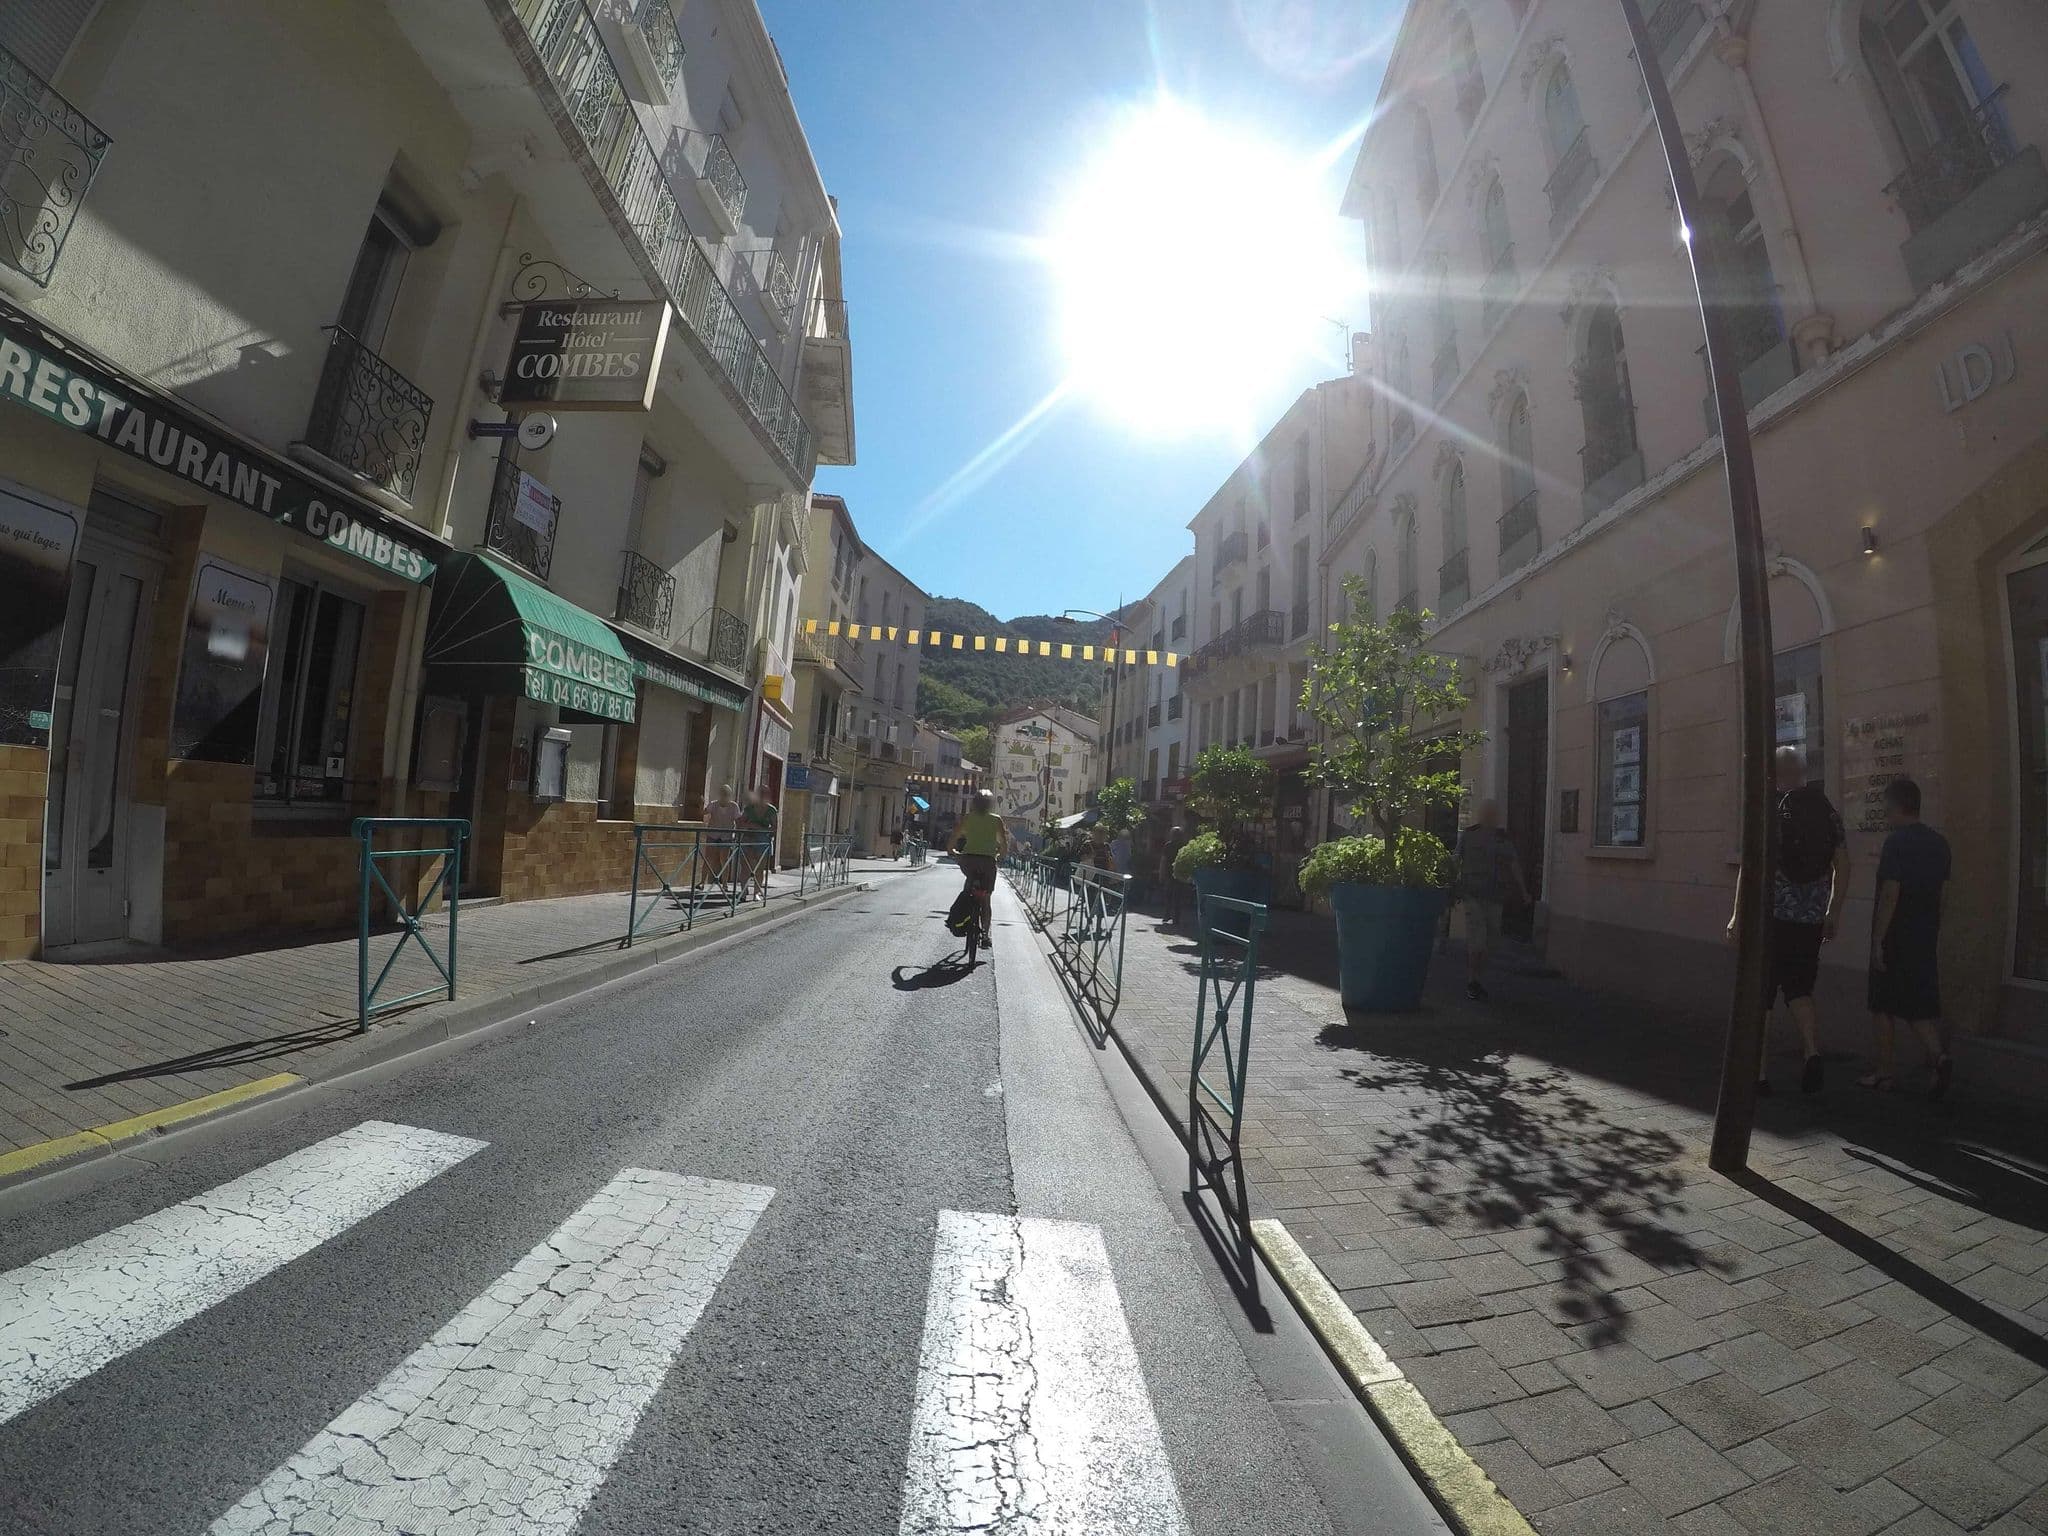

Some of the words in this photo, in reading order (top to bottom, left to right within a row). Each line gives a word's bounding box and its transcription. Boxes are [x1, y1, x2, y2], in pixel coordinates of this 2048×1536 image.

[537, 309, 643, 327] Restaurant
[516, 353, 641, 379] COMBES
[0, 338, 281, 514] RESTAURANT
[305, 500, 428, 581] COMBES
[530, 631, 629, 692] COMBES
[552, 680, 570, 705] 04
[592, 692, 605, 713] 87
[608, 697, 622, 719] 85
